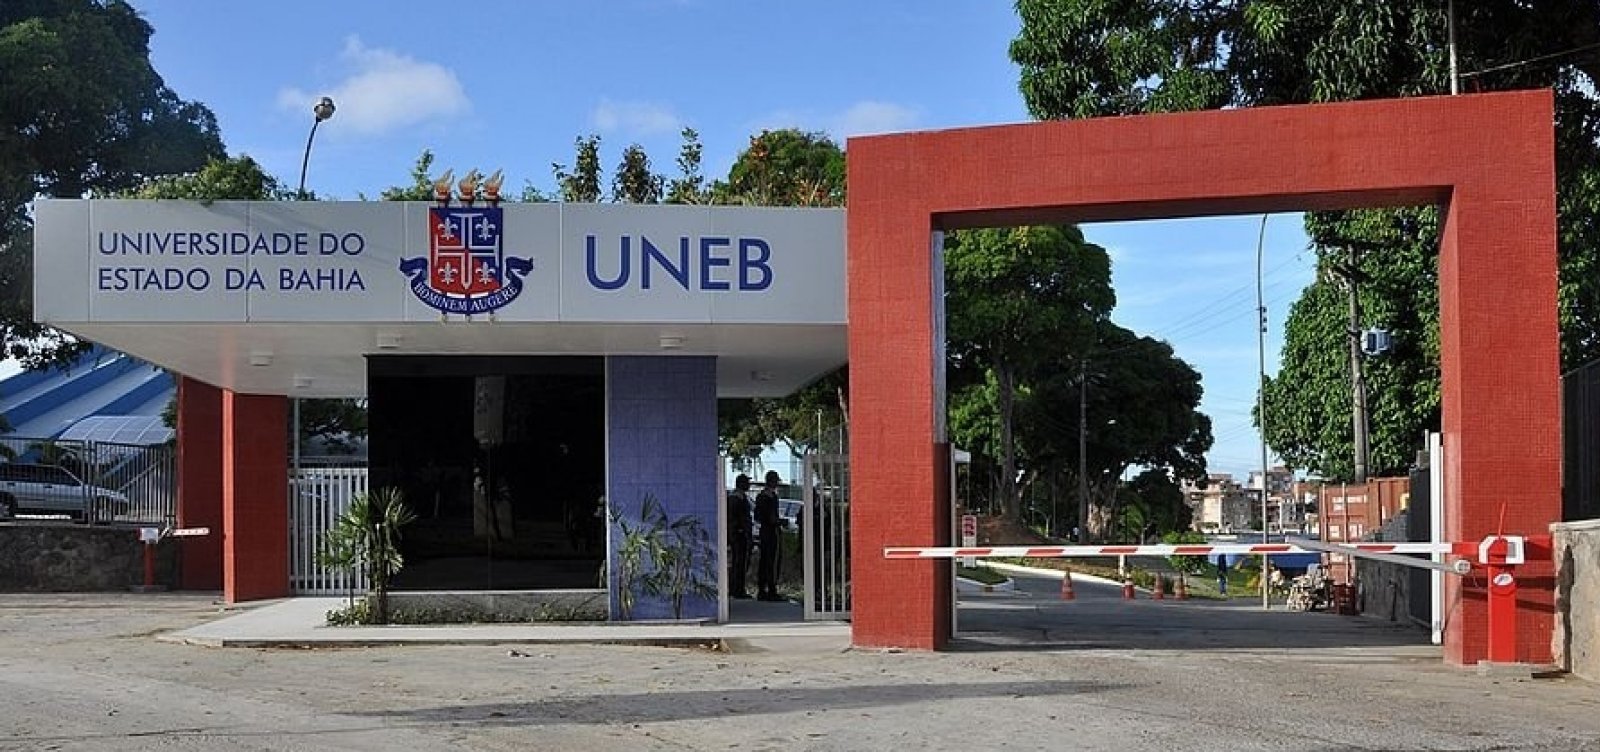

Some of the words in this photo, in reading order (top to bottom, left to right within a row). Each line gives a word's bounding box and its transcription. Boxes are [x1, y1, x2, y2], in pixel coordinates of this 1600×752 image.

[98, 231, 308, 256] UNIVERSIDADE
[319, 231, 365, 255] DO
[585, 234, 773, 291] UNEB
[98, 267, 211, 292] ESTADO
[225, 267, 266, 291] DA
[279, 267, 366, 292] BAHIA
[413, 281, 468, 311] HOMINEM
[469, 285, 519, 311] AUGERE
